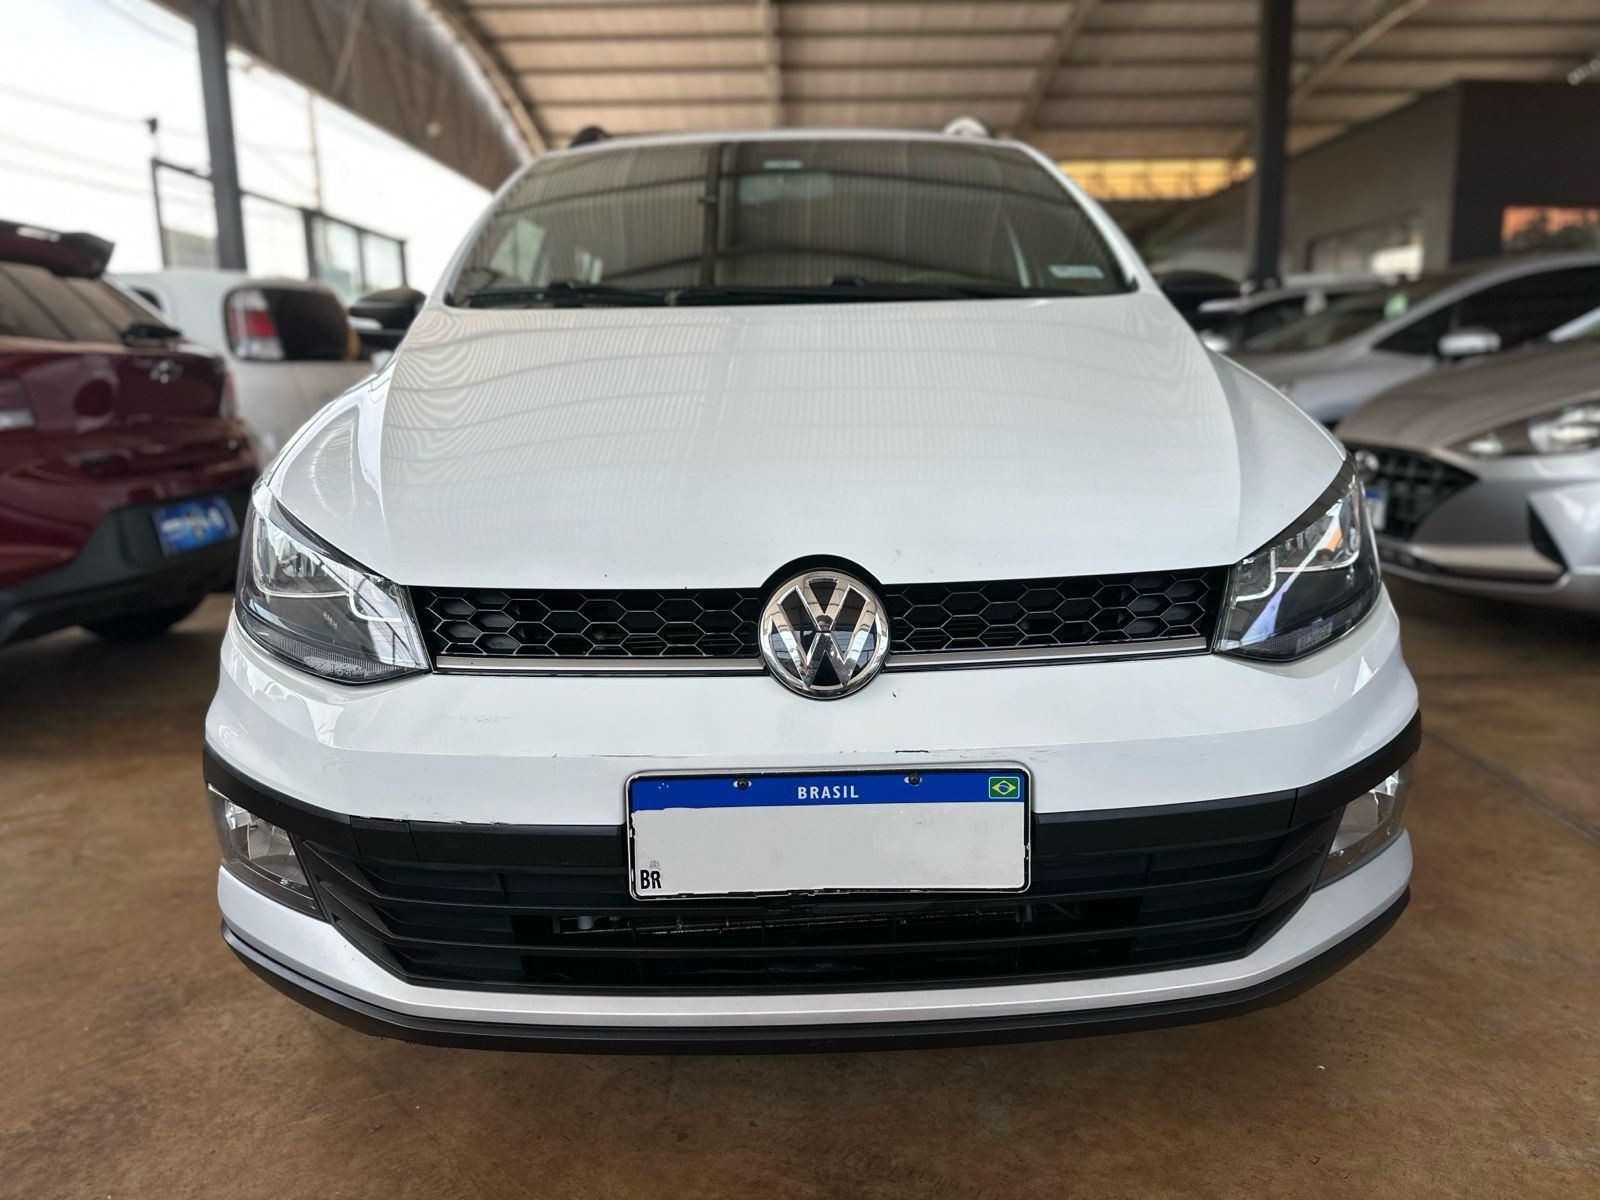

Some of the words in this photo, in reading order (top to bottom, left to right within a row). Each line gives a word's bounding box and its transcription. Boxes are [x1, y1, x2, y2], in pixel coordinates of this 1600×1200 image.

[766, 575, 881, 691] VW
[797, 785, 859, 800] BRASIL
[640, 869, 662, 889] BR
